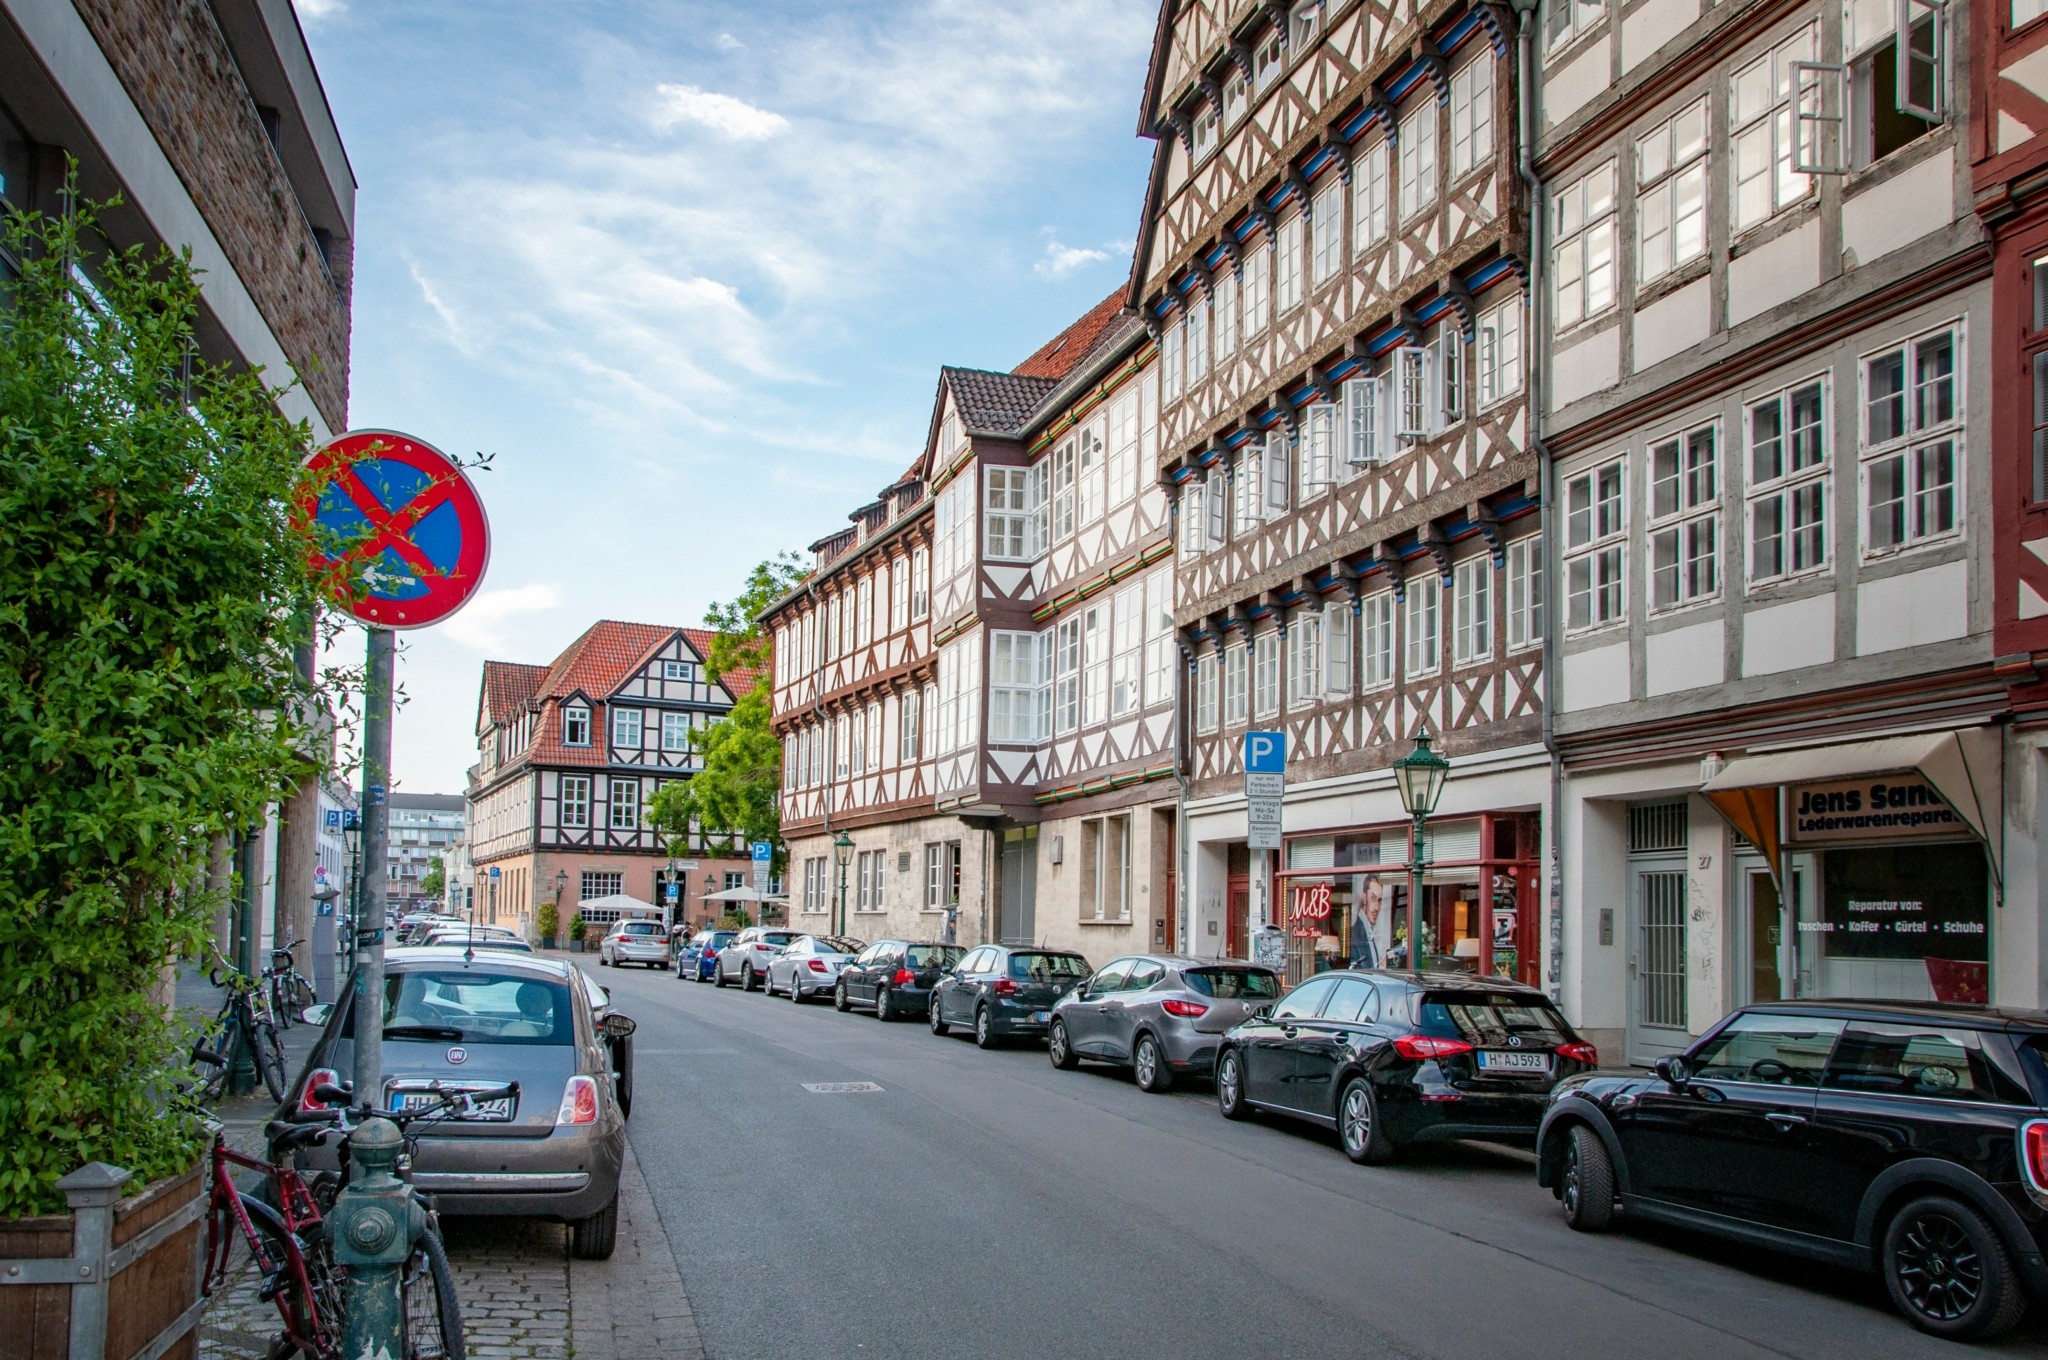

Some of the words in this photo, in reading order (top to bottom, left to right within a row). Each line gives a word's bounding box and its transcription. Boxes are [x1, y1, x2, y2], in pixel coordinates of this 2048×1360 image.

[1251, 736, 1273, 767] P
[1251, 799, 1279, 807] werktags
[1798, 789, 1861, 815] Jens
[329, 812, 337, 826] P
[755, 844, 766, 858] P
[1698, 855, 1711, 869] 27
[1289, 884, 1329, 919] M&B
[1848, 900, 1898, 912] Reparatur
[1899, 901, 1923, 911] von:
[323, 903, 332, 915] P
[1798, 922, 1834, 932] Taschen
[1848, 921, 1880, 932] Koffer
[1895, 920, 1927, 932] Gürtel
[1943, 921, 1984, 933] Schuhe
[450, 1051, 463, 1059] FIAT
